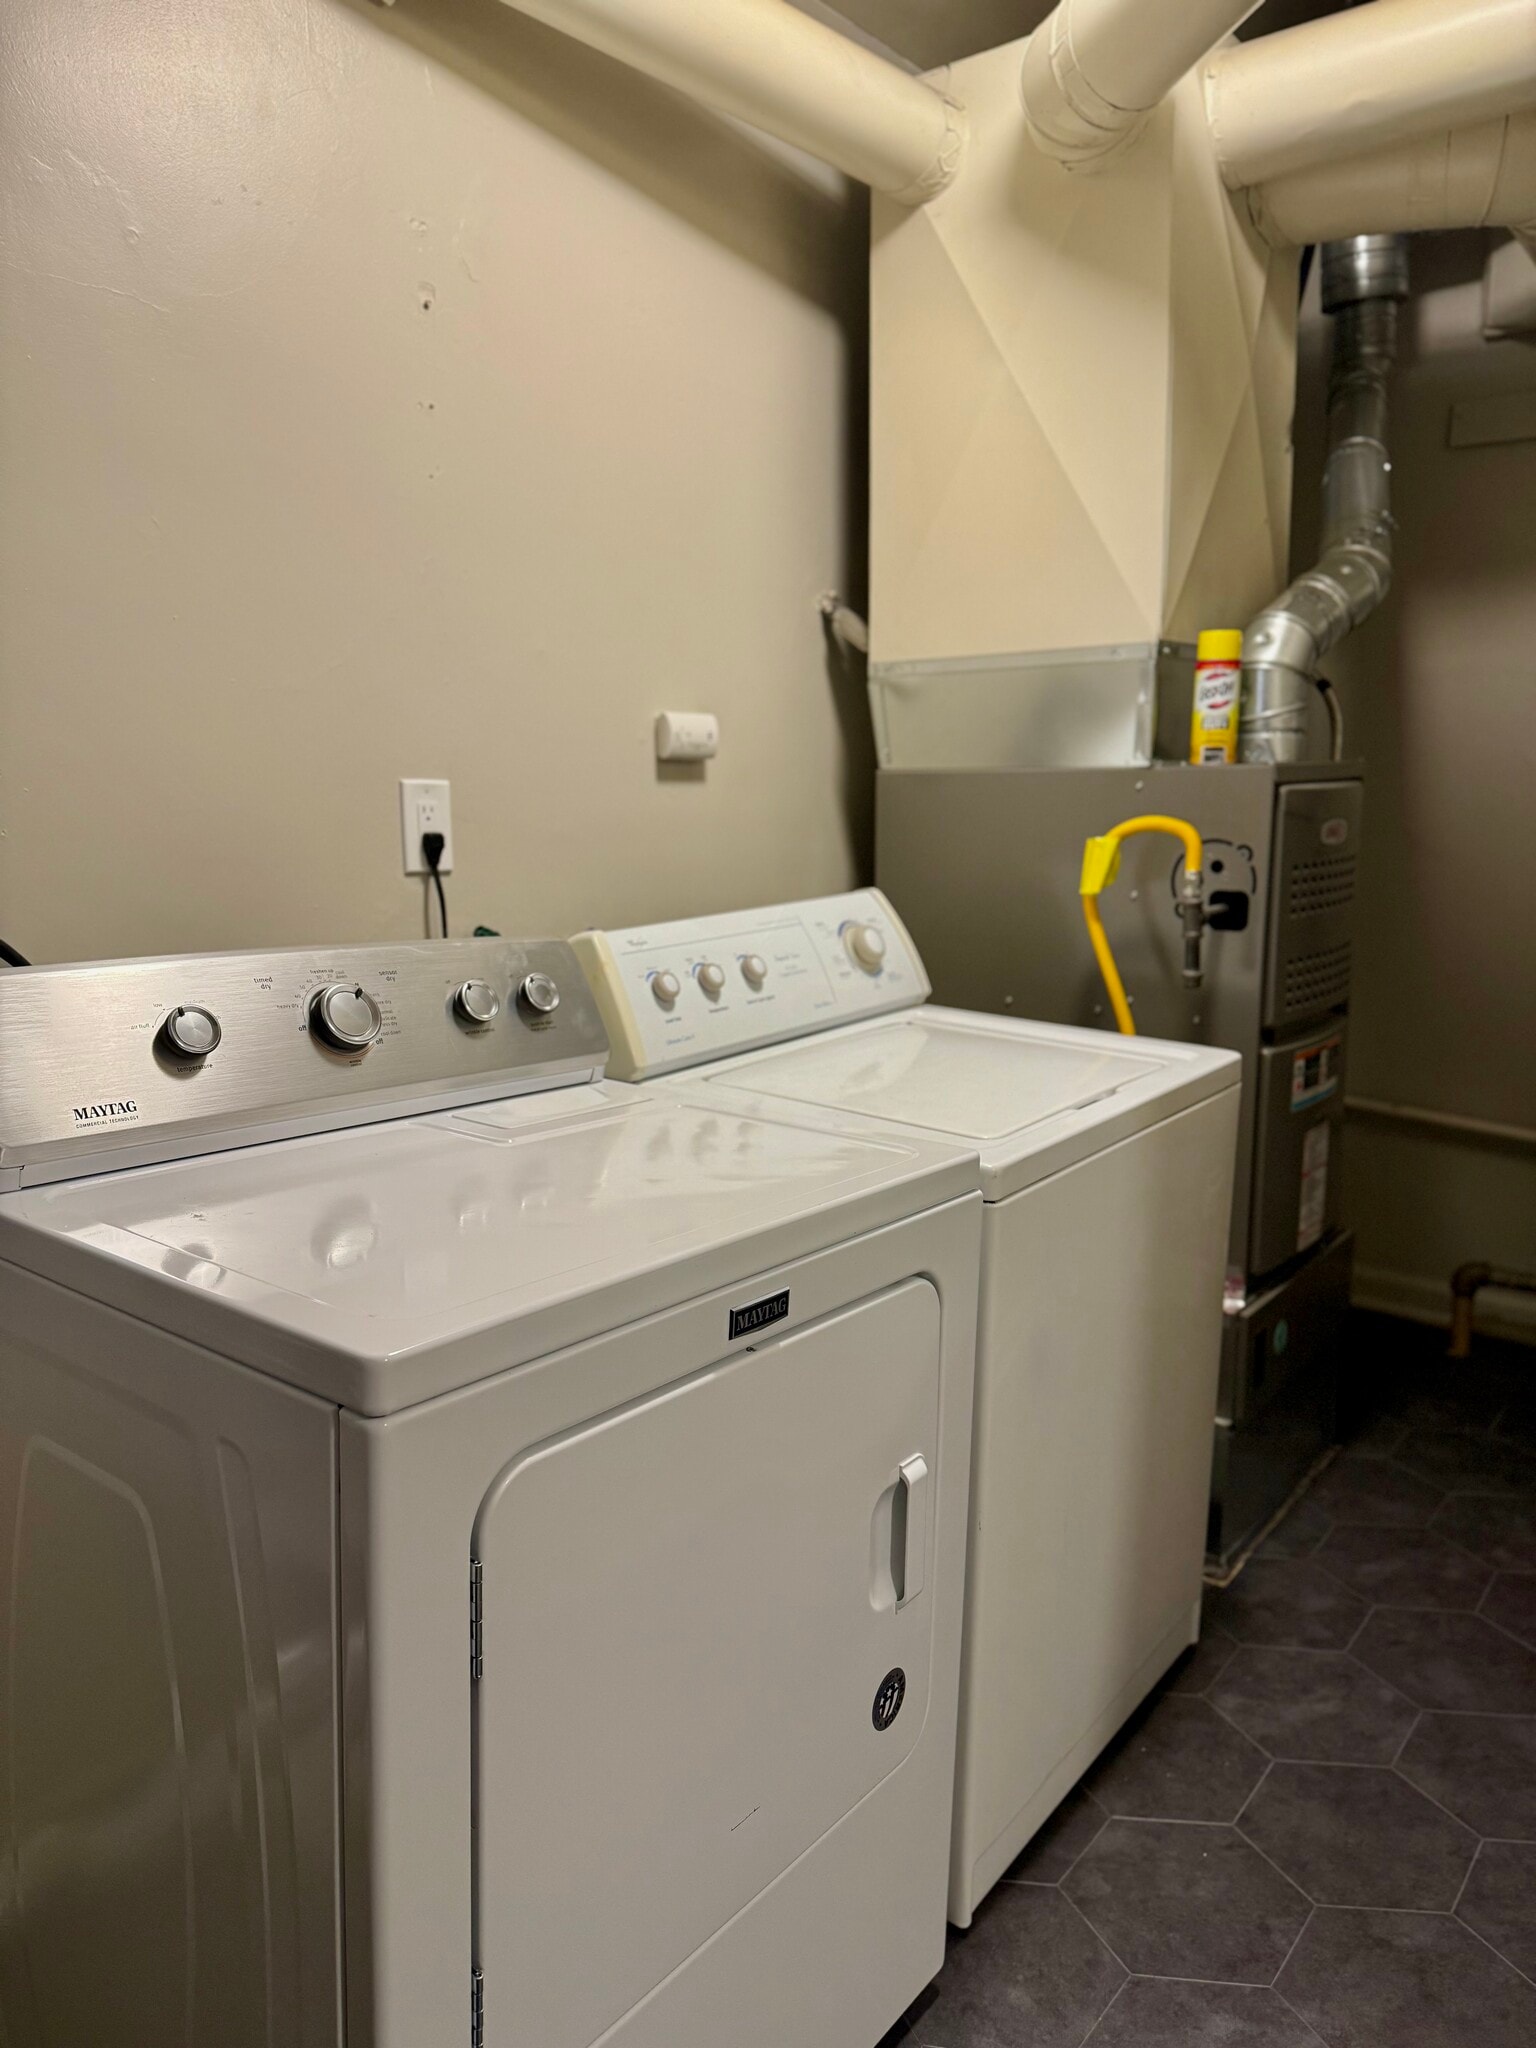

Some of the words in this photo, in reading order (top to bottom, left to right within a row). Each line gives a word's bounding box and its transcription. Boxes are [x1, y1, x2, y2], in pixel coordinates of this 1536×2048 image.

[253, 976, 273, 984] timed
[298, 1024, 308, 1032] off
[176, 1063, 214, 1073] temperature
[72, 1100, 137, 1120] MAYTAG
[75, 1120, 108, 1129] COMMERCIAL
[109, 1115, 139, 1125] TECHNOLOGY
[736, 1296, 788, 1332] MAYTAG
